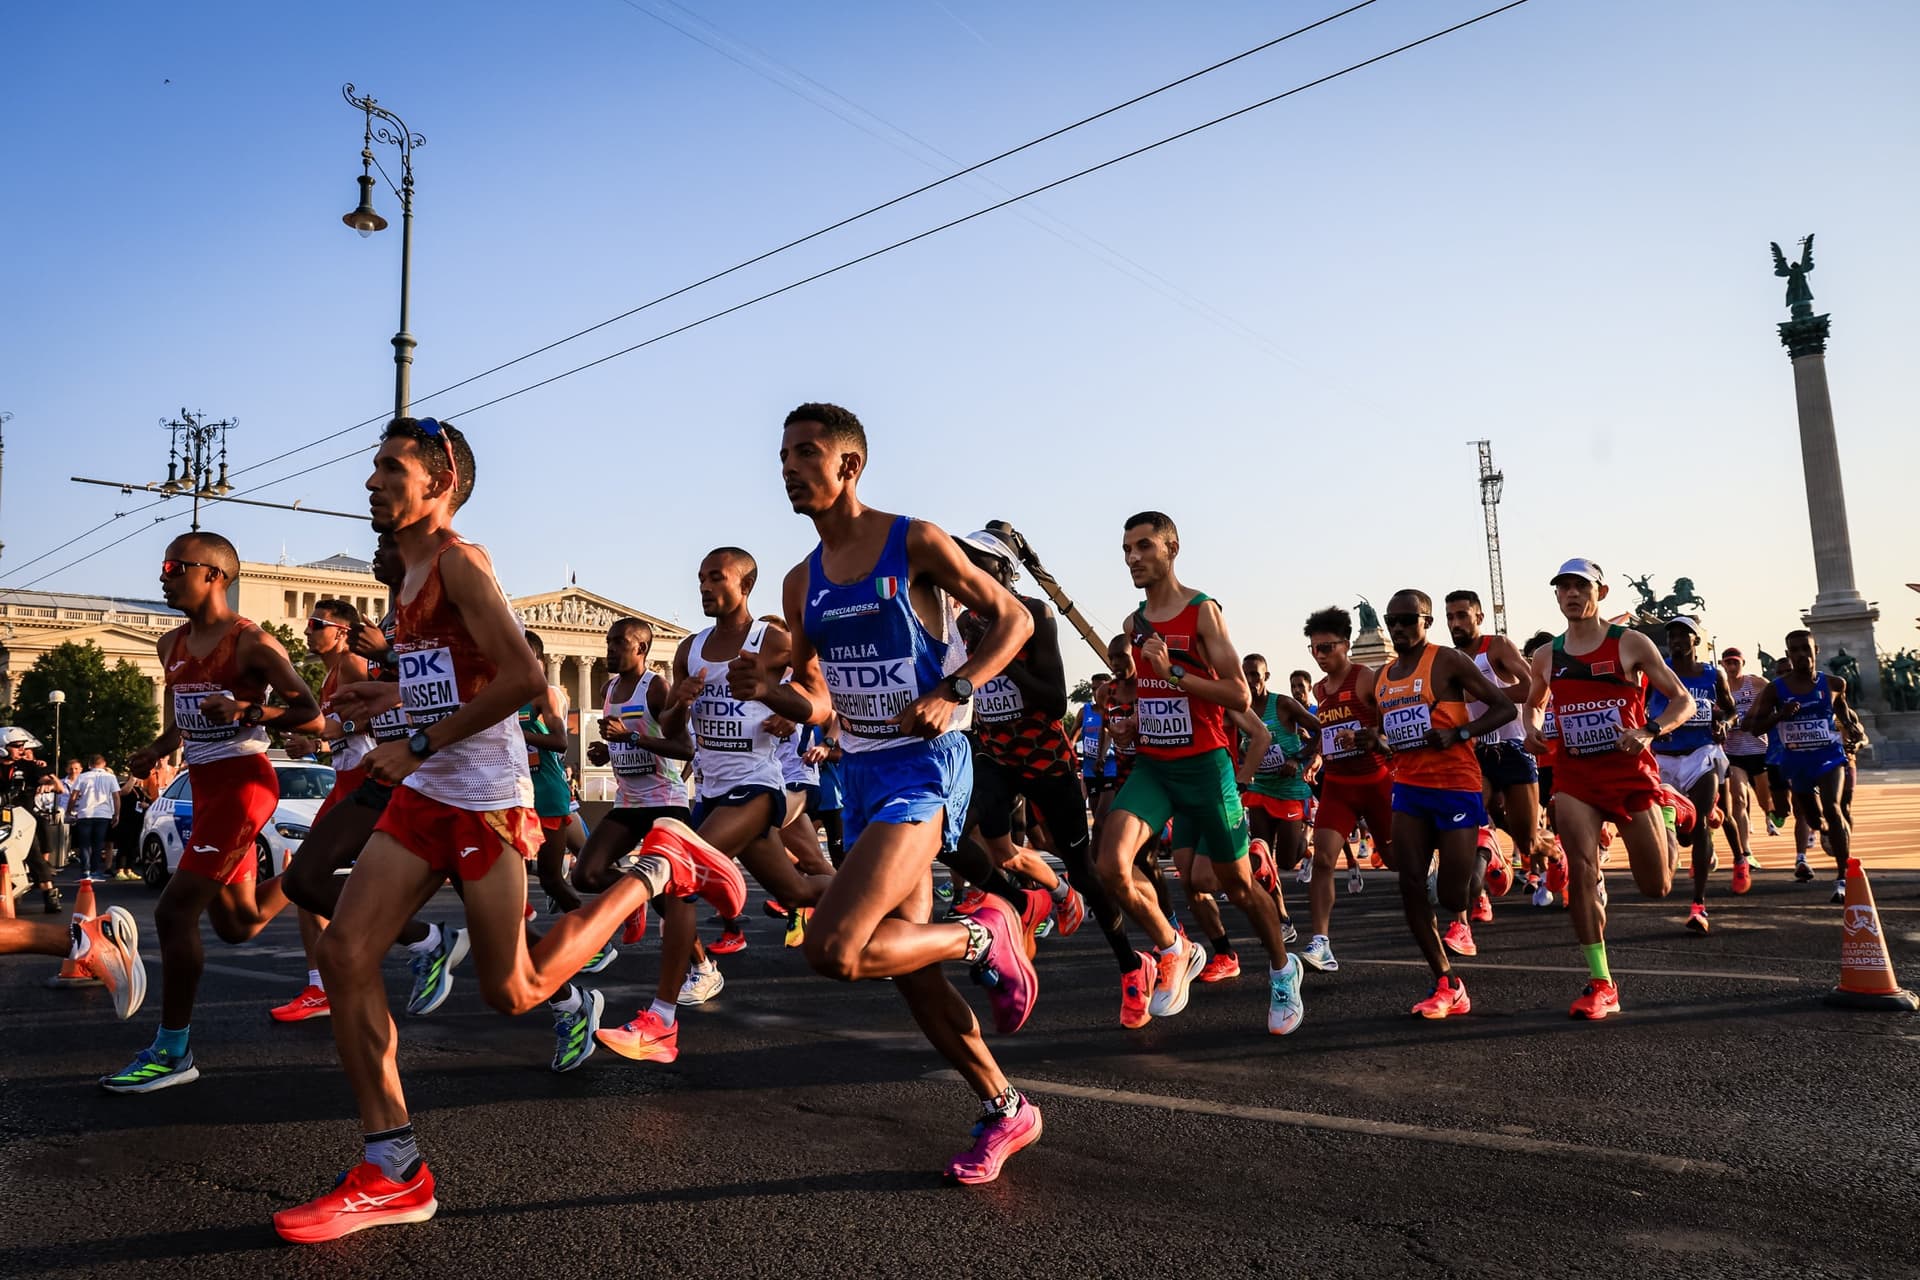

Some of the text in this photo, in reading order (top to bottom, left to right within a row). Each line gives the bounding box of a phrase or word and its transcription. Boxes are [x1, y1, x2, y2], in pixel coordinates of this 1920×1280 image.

[822, 603, 880, 617] FRECCIAROSSA
[830, 643, 879, 660] ITALIA
[400, 651, 446, 679] DK
[837, 662, 907, 687] TDK
[700, 684, 733, 698] RAE
[702, 701, 746, 717] TDK
[1143, 700, 1185, 714] TDK
[1560, 698, 1627, 713] MOROCCO
[1318, 705, 1353, 724] CHINA
[1390, 706, 1425, 725] TDK
[1572, 710, 1616, 728] TDK
[697, 718, 742, 737] TEFERI
[851, 723, 900, 734] BUDAPEST
[1140, 717, 1188, 734] HOUDADI
[1794, 720, 1825, 730] TDK
[704, 739, 747, 749] BUDAPEST 23
[1149, 736, 1190, 745] BUDAPEST 23
[1564, 732, 1576, 746] EL
[1580, 743, 1615, 754] BUDAPEST
